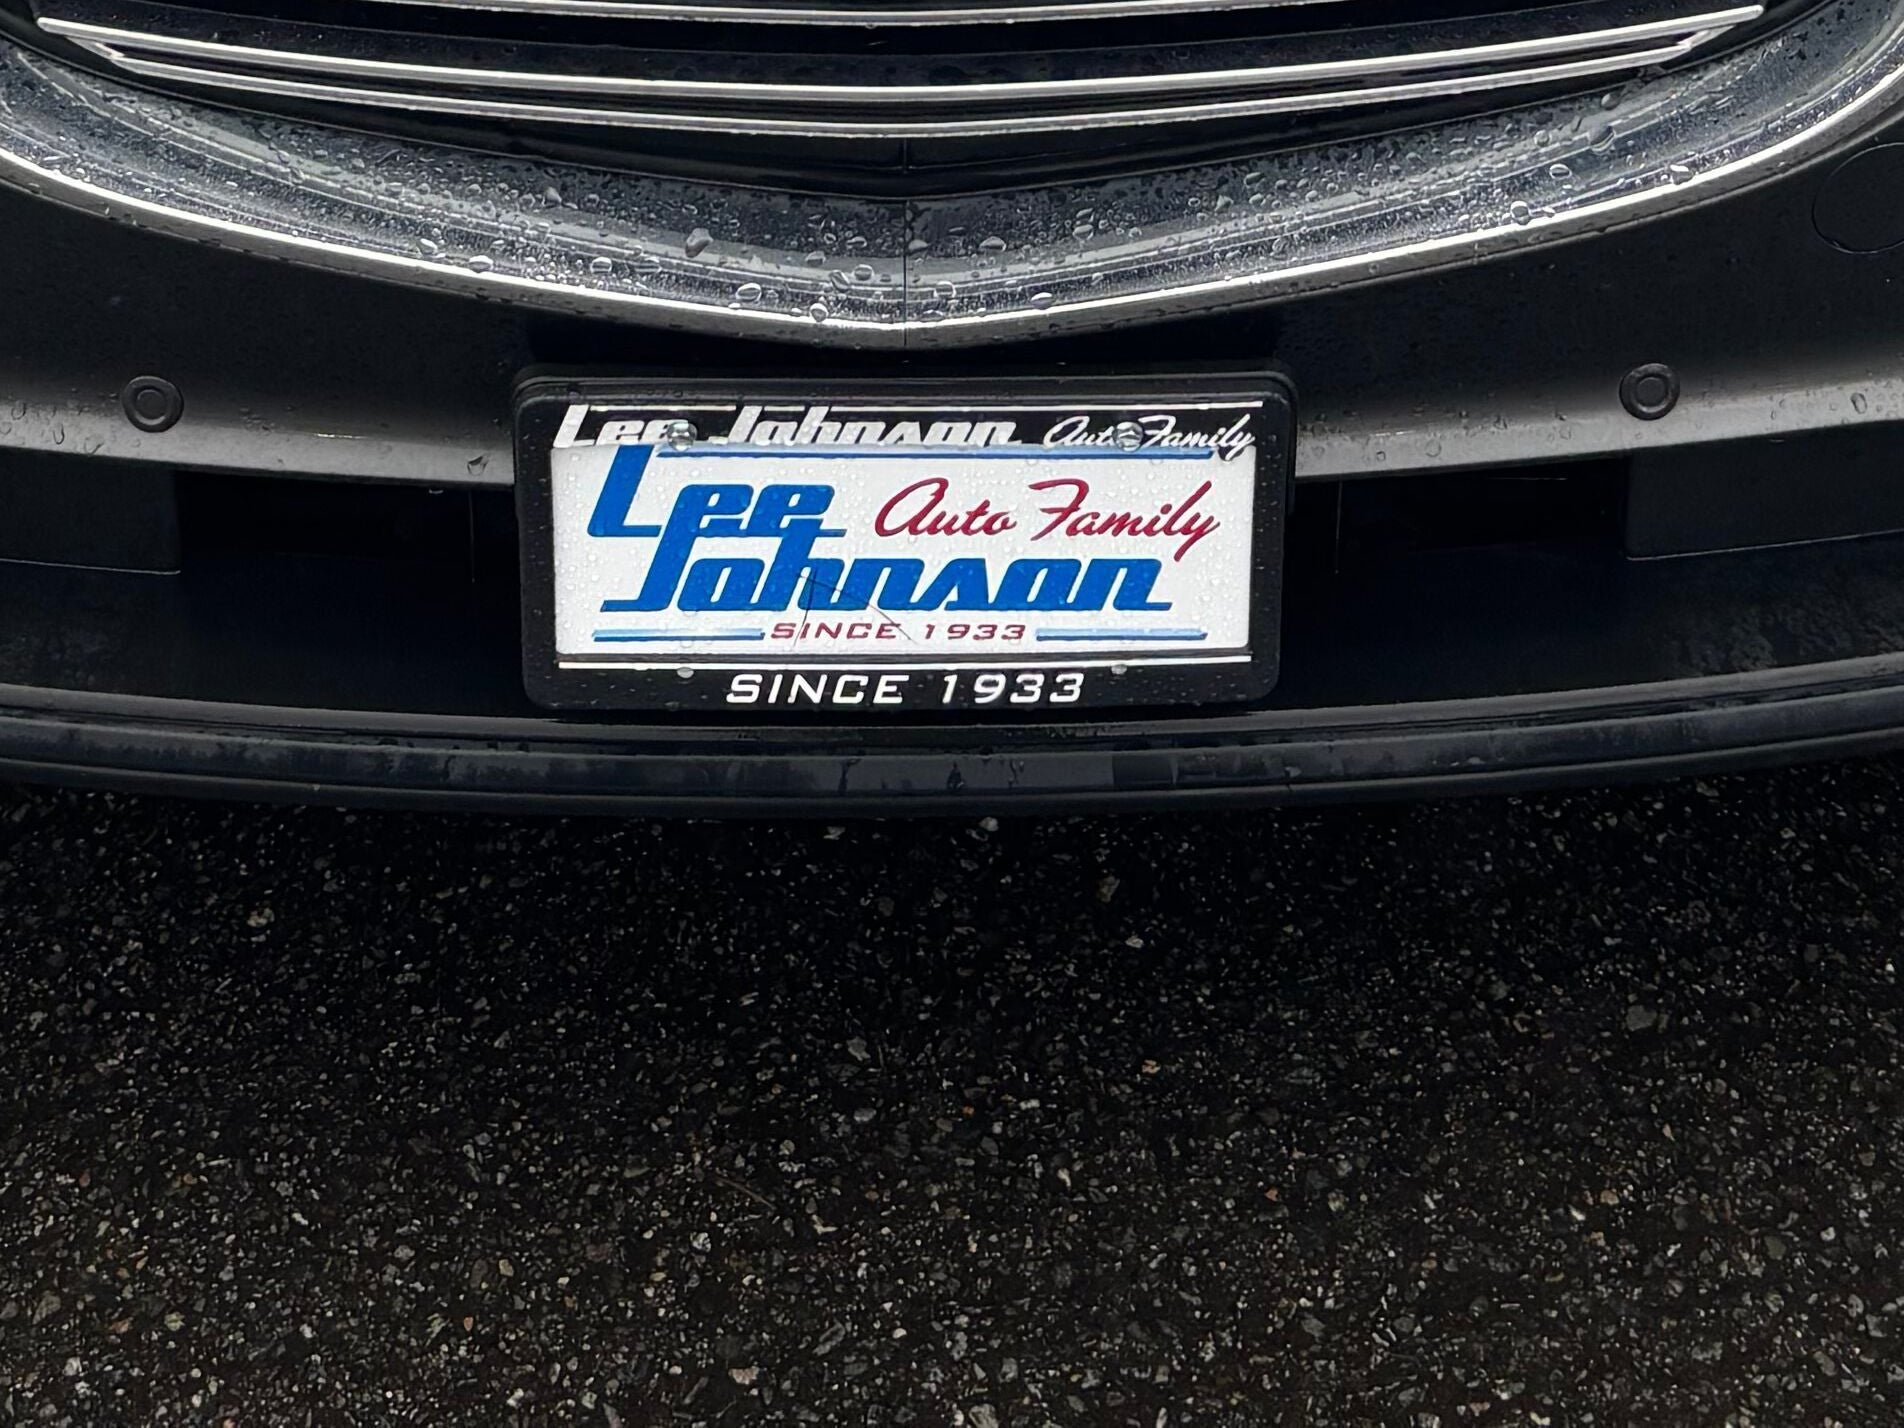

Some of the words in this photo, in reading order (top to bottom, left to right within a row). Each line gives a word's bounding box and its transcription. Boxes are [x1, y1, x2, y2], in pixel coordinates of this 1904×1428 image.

[708, 404, 1022, 446] Johnson
[1043, 415, 1132, 449] Aut
[1136, 413, 1256, 461] Family
[587, 444, 848, 538] Lee
[874, 477, 1017, 537] Auto
[1028, 478, 1220, 562] Family
[599, 532, 1173, 612] Johnson
[771, 622, 901, 640] SINCE
[925, 623, 1026, 641] 1933
[726, 674, 910, 704] SINCE
[942, 673, 1085, 704] 1933
